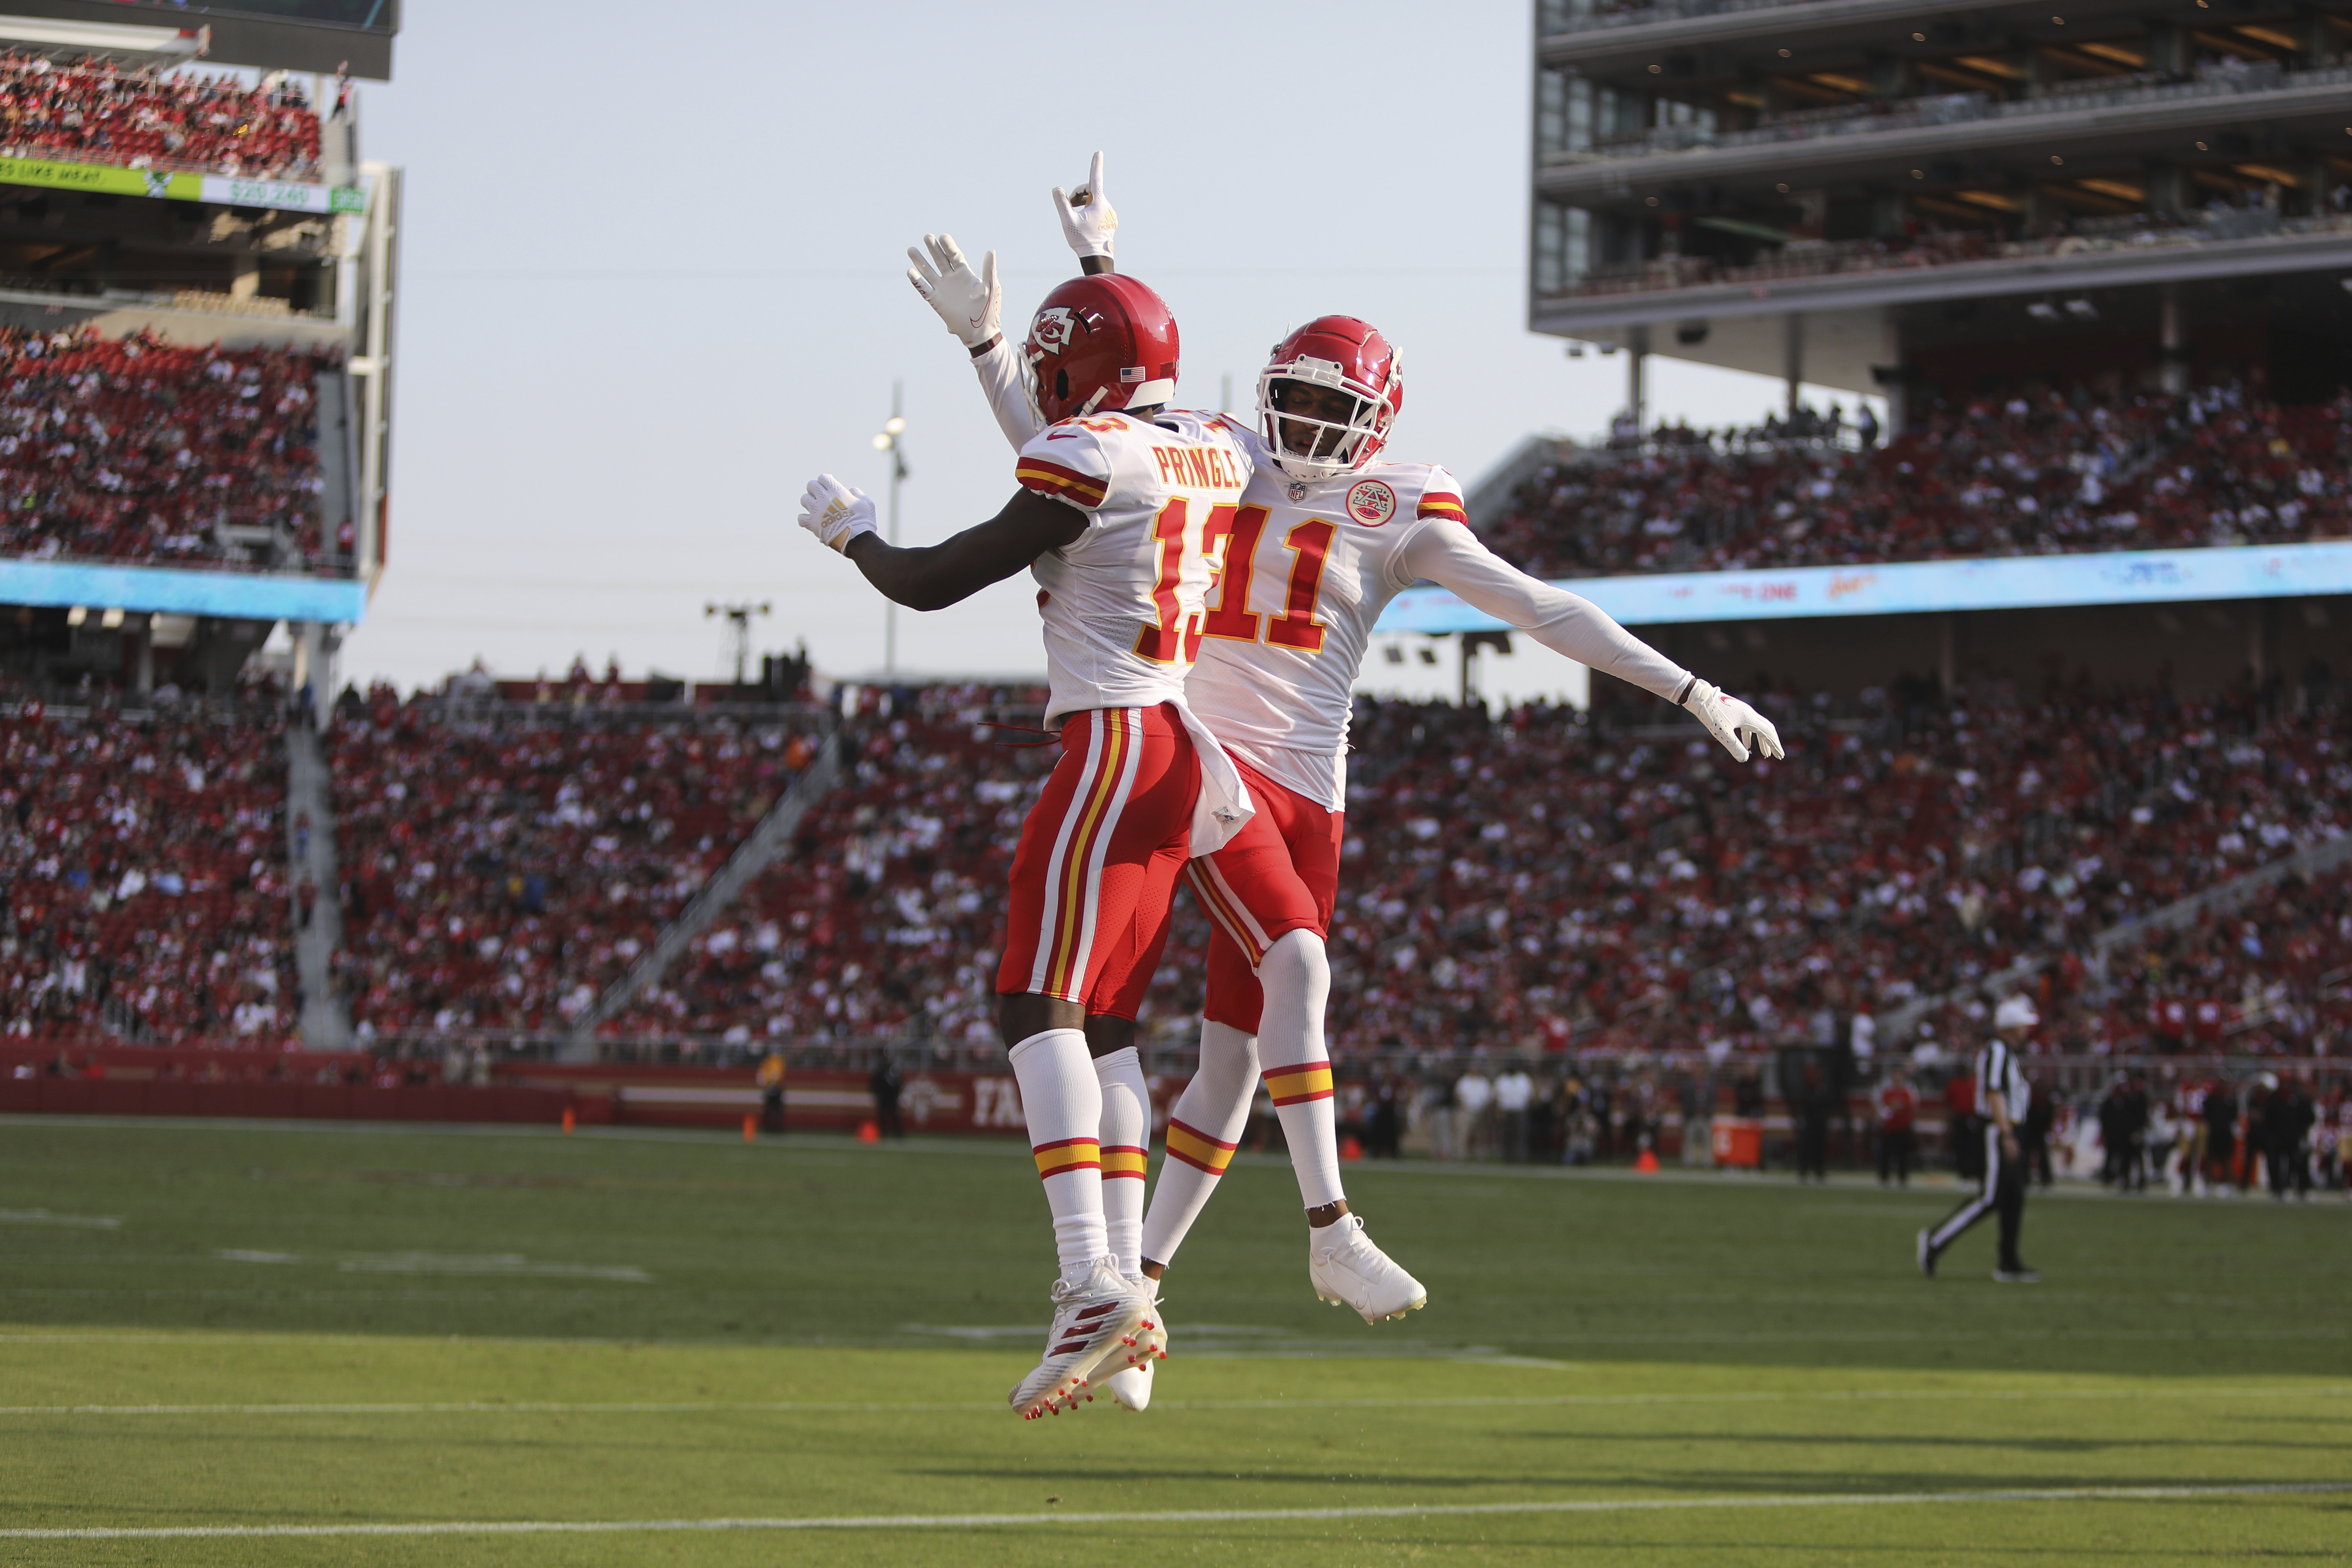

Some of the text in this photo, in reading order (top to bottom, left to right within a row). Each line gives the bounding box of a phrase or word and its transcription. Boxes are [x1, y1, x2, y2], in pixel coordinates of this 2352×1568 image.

[1150, 446, 1240, 489] PRINGLE
[1290, 489, 1303, 499] NFL
[821, 509, 855, 527] adidas
[1202, 502, 1338, 654] 11
